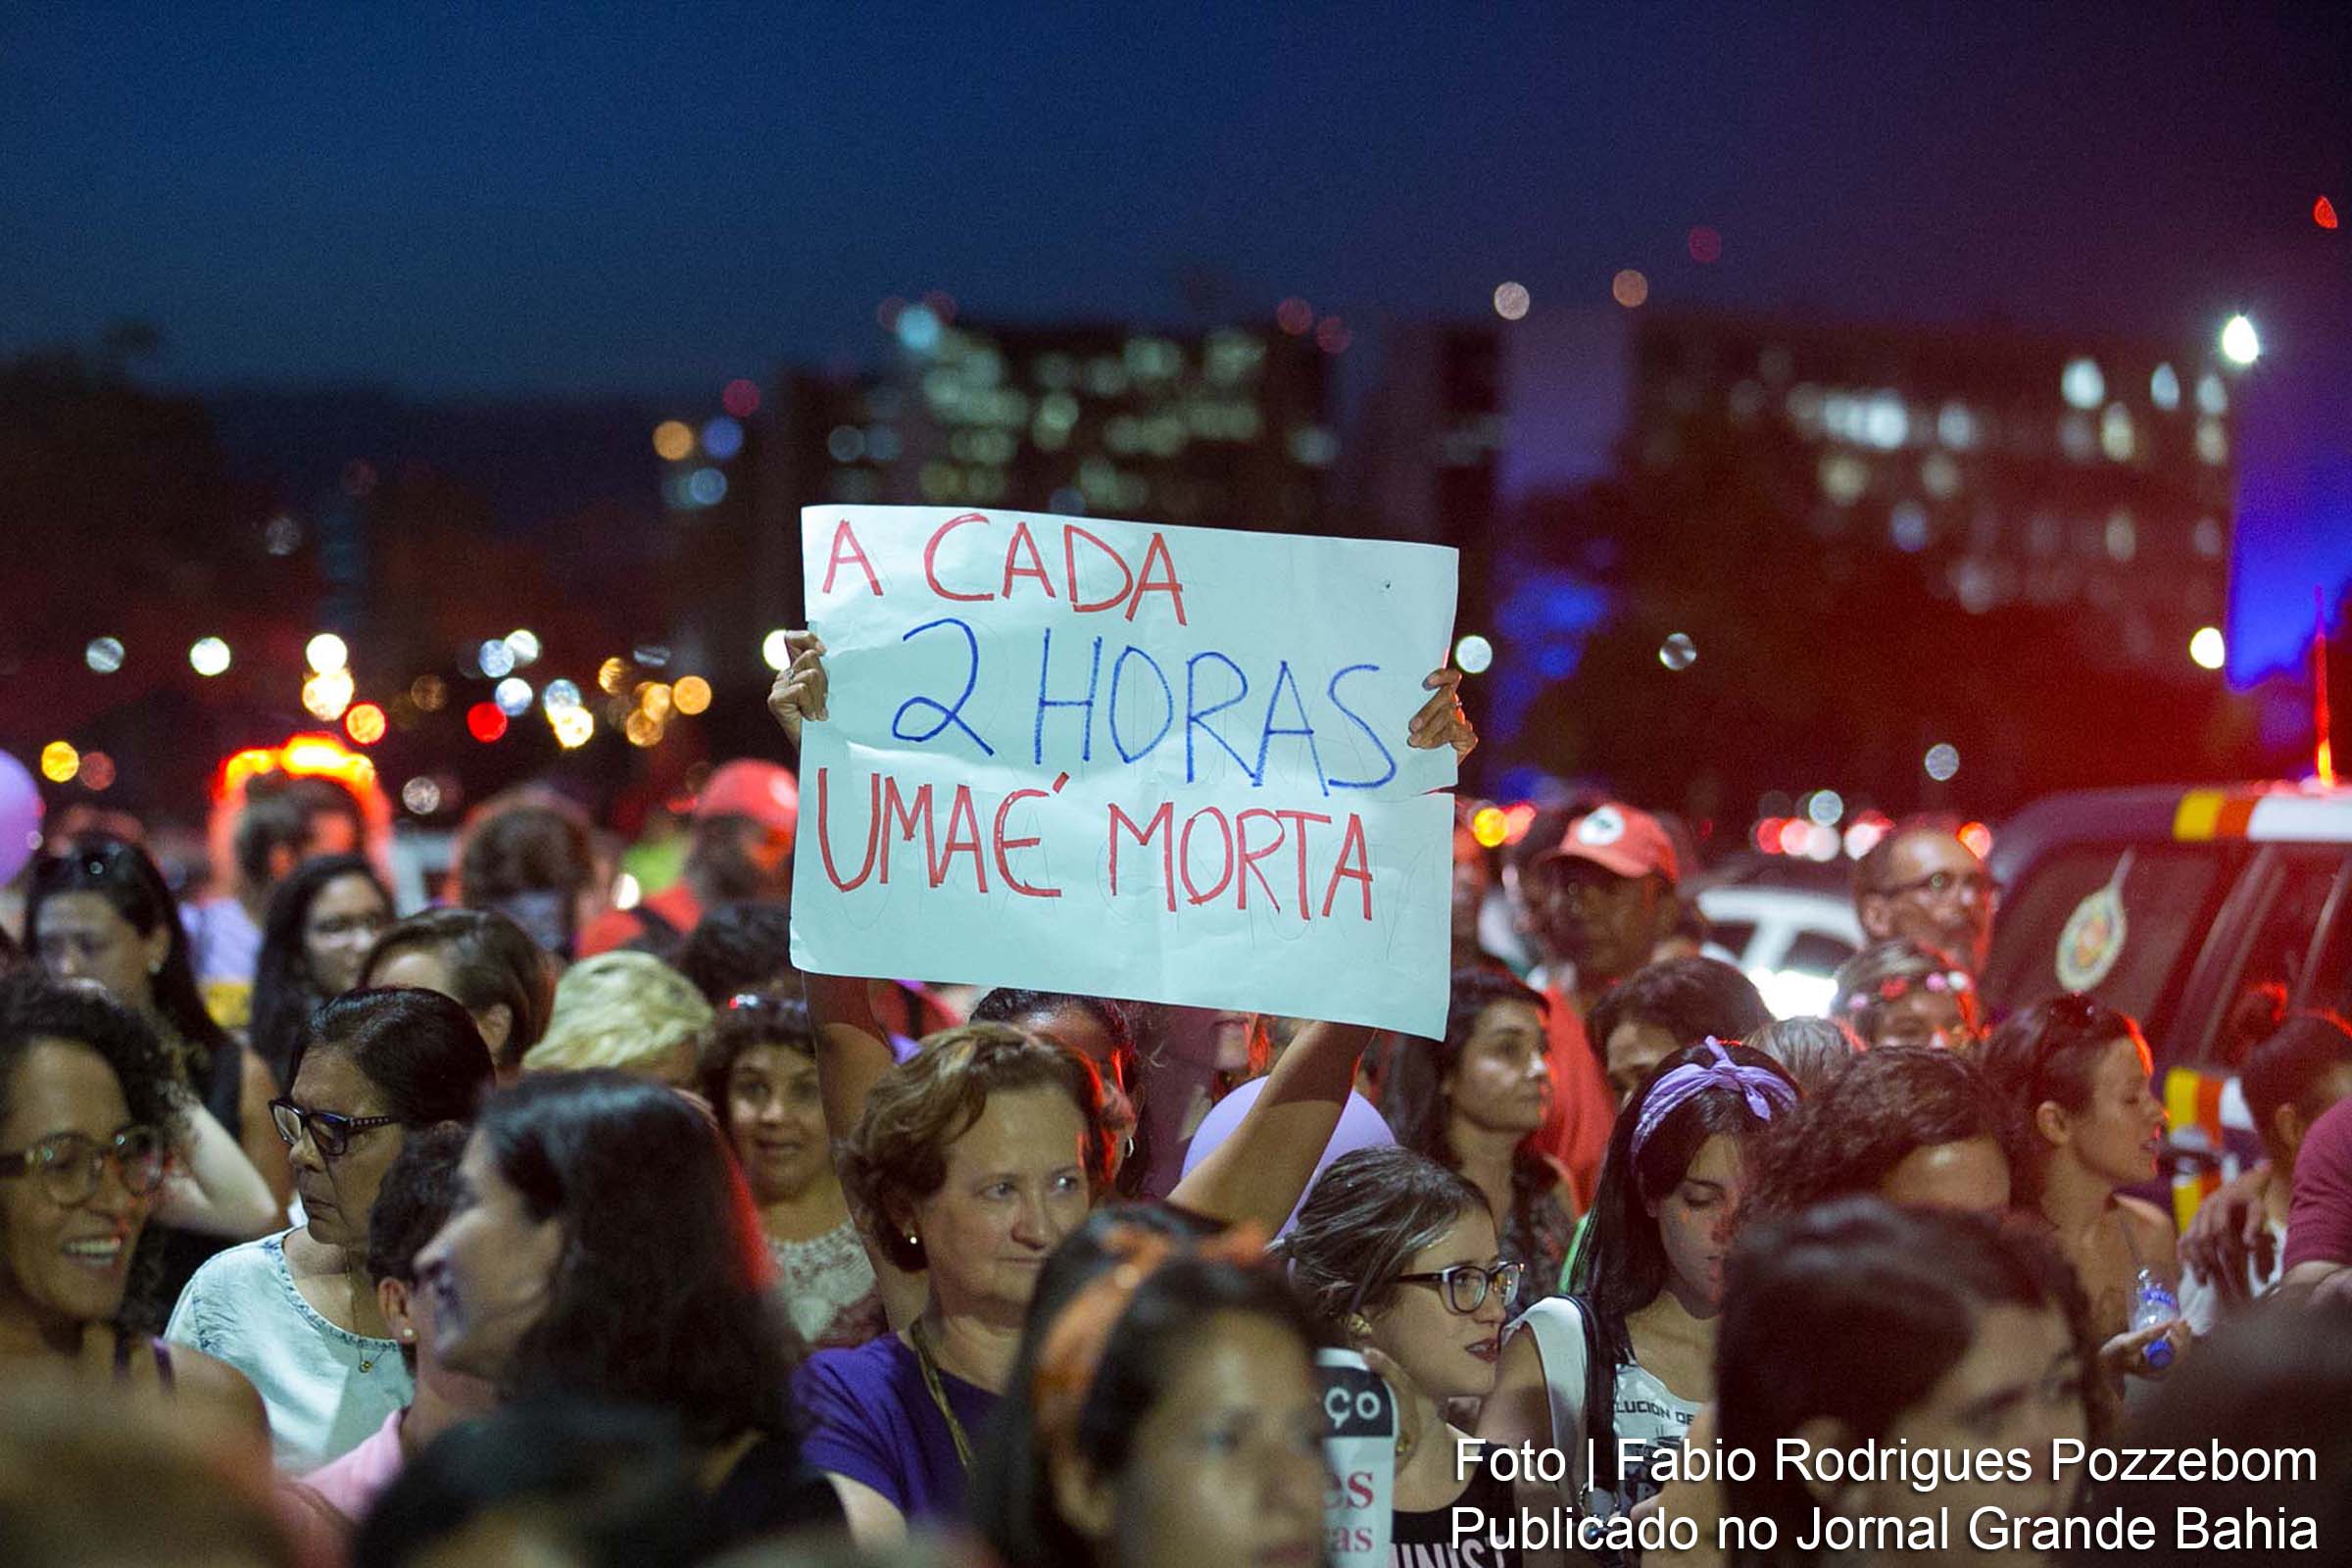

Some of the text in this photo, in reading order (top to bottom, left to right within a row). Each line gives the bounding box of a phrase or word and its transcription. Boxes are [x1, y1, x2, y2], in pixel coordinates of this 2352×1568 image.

[822, 514, 1187, 625] A CADA
[891, 617, 1396, 797] 2 HORAS
[1108, 802, 1372, 920] MORTA
[1616, 1400, 1671, 1419] LUCION
